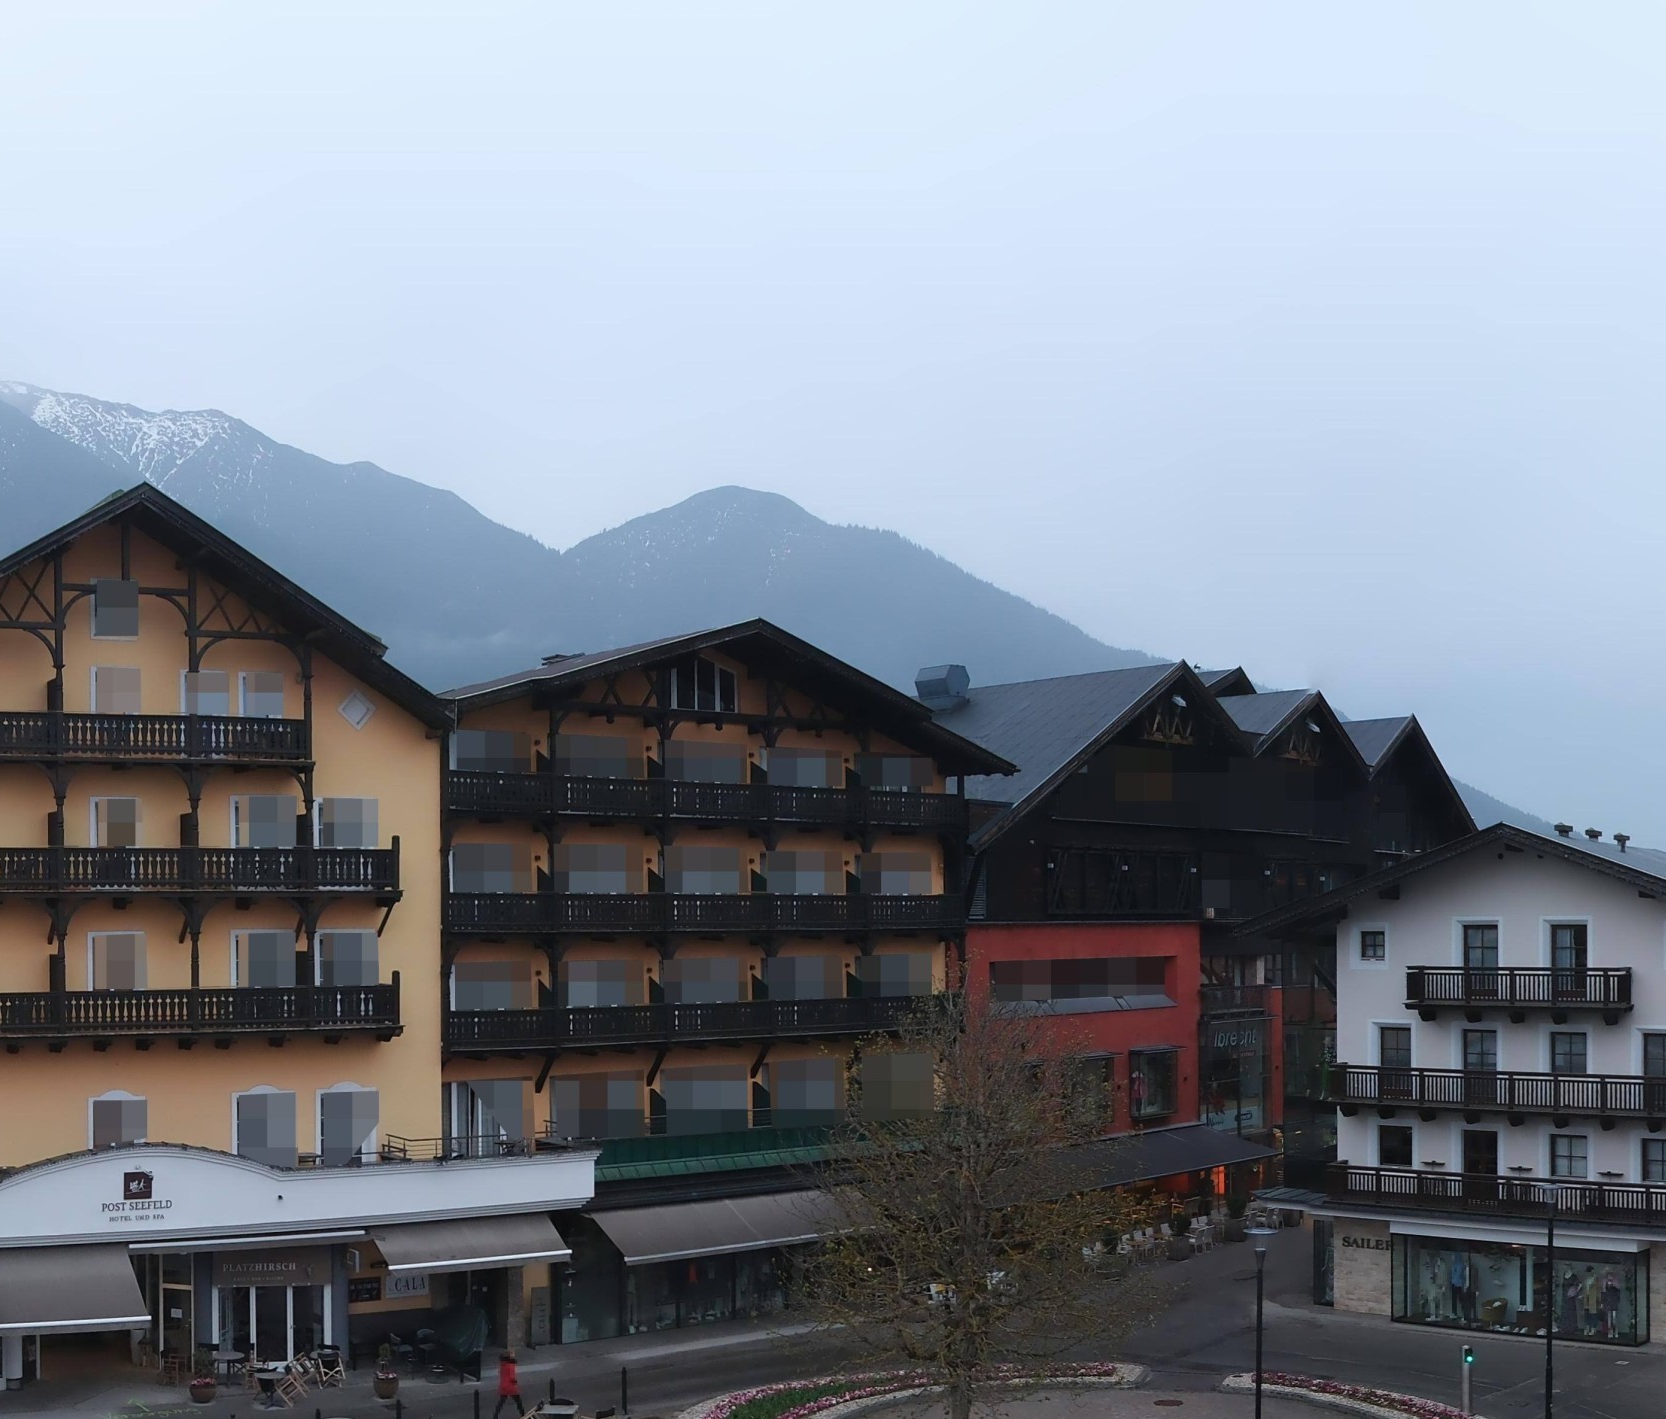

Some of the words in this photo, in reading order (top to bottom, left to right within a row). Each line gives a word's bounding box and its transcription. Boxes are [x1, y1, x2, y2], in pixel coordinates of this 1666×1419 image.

[101, 1201, 127, 1212] POST
[129, 1199, 173, 1211] SEEFELD
[222, 1262, 296, 1272] PLATZHIRSCH
